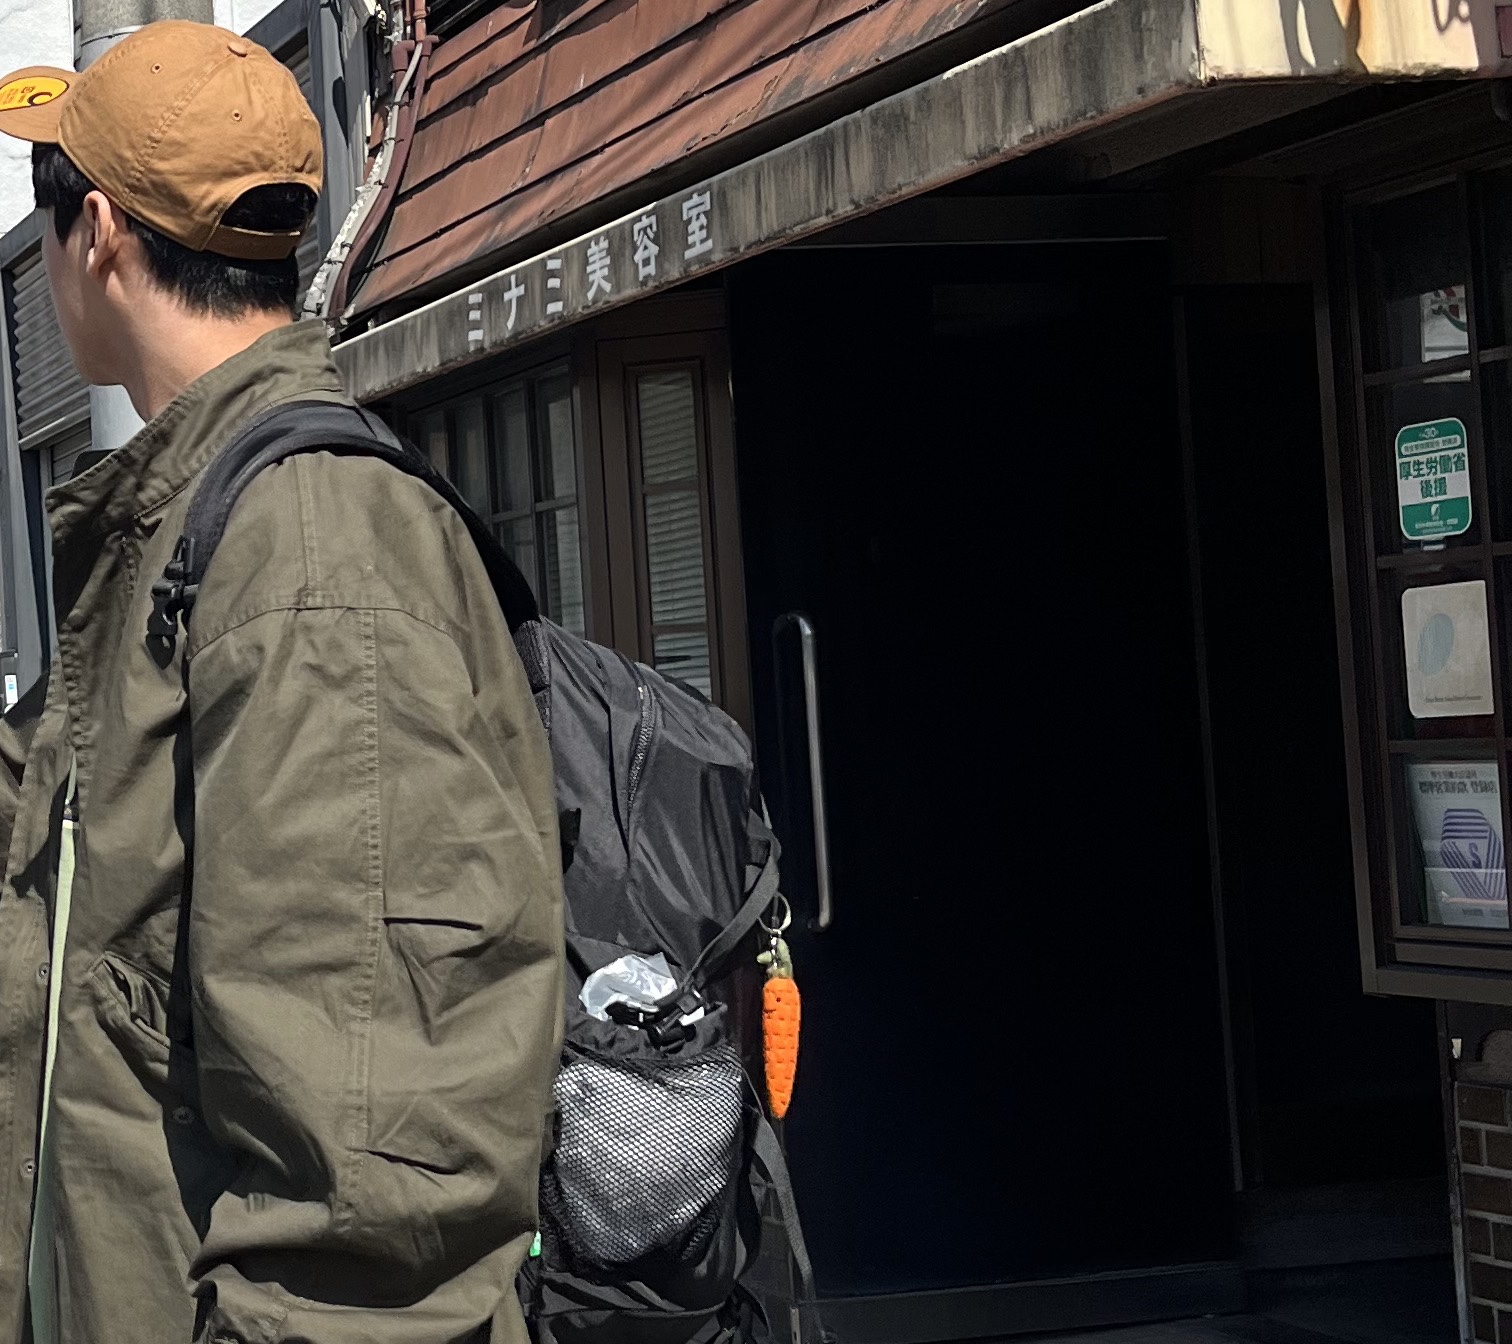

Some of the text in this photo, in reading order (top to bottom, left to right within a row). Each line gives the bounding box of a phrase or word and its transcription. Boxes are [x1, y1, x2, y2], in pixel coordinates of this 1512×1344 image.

[467, 190, 714, 351] ミナミ美容室
